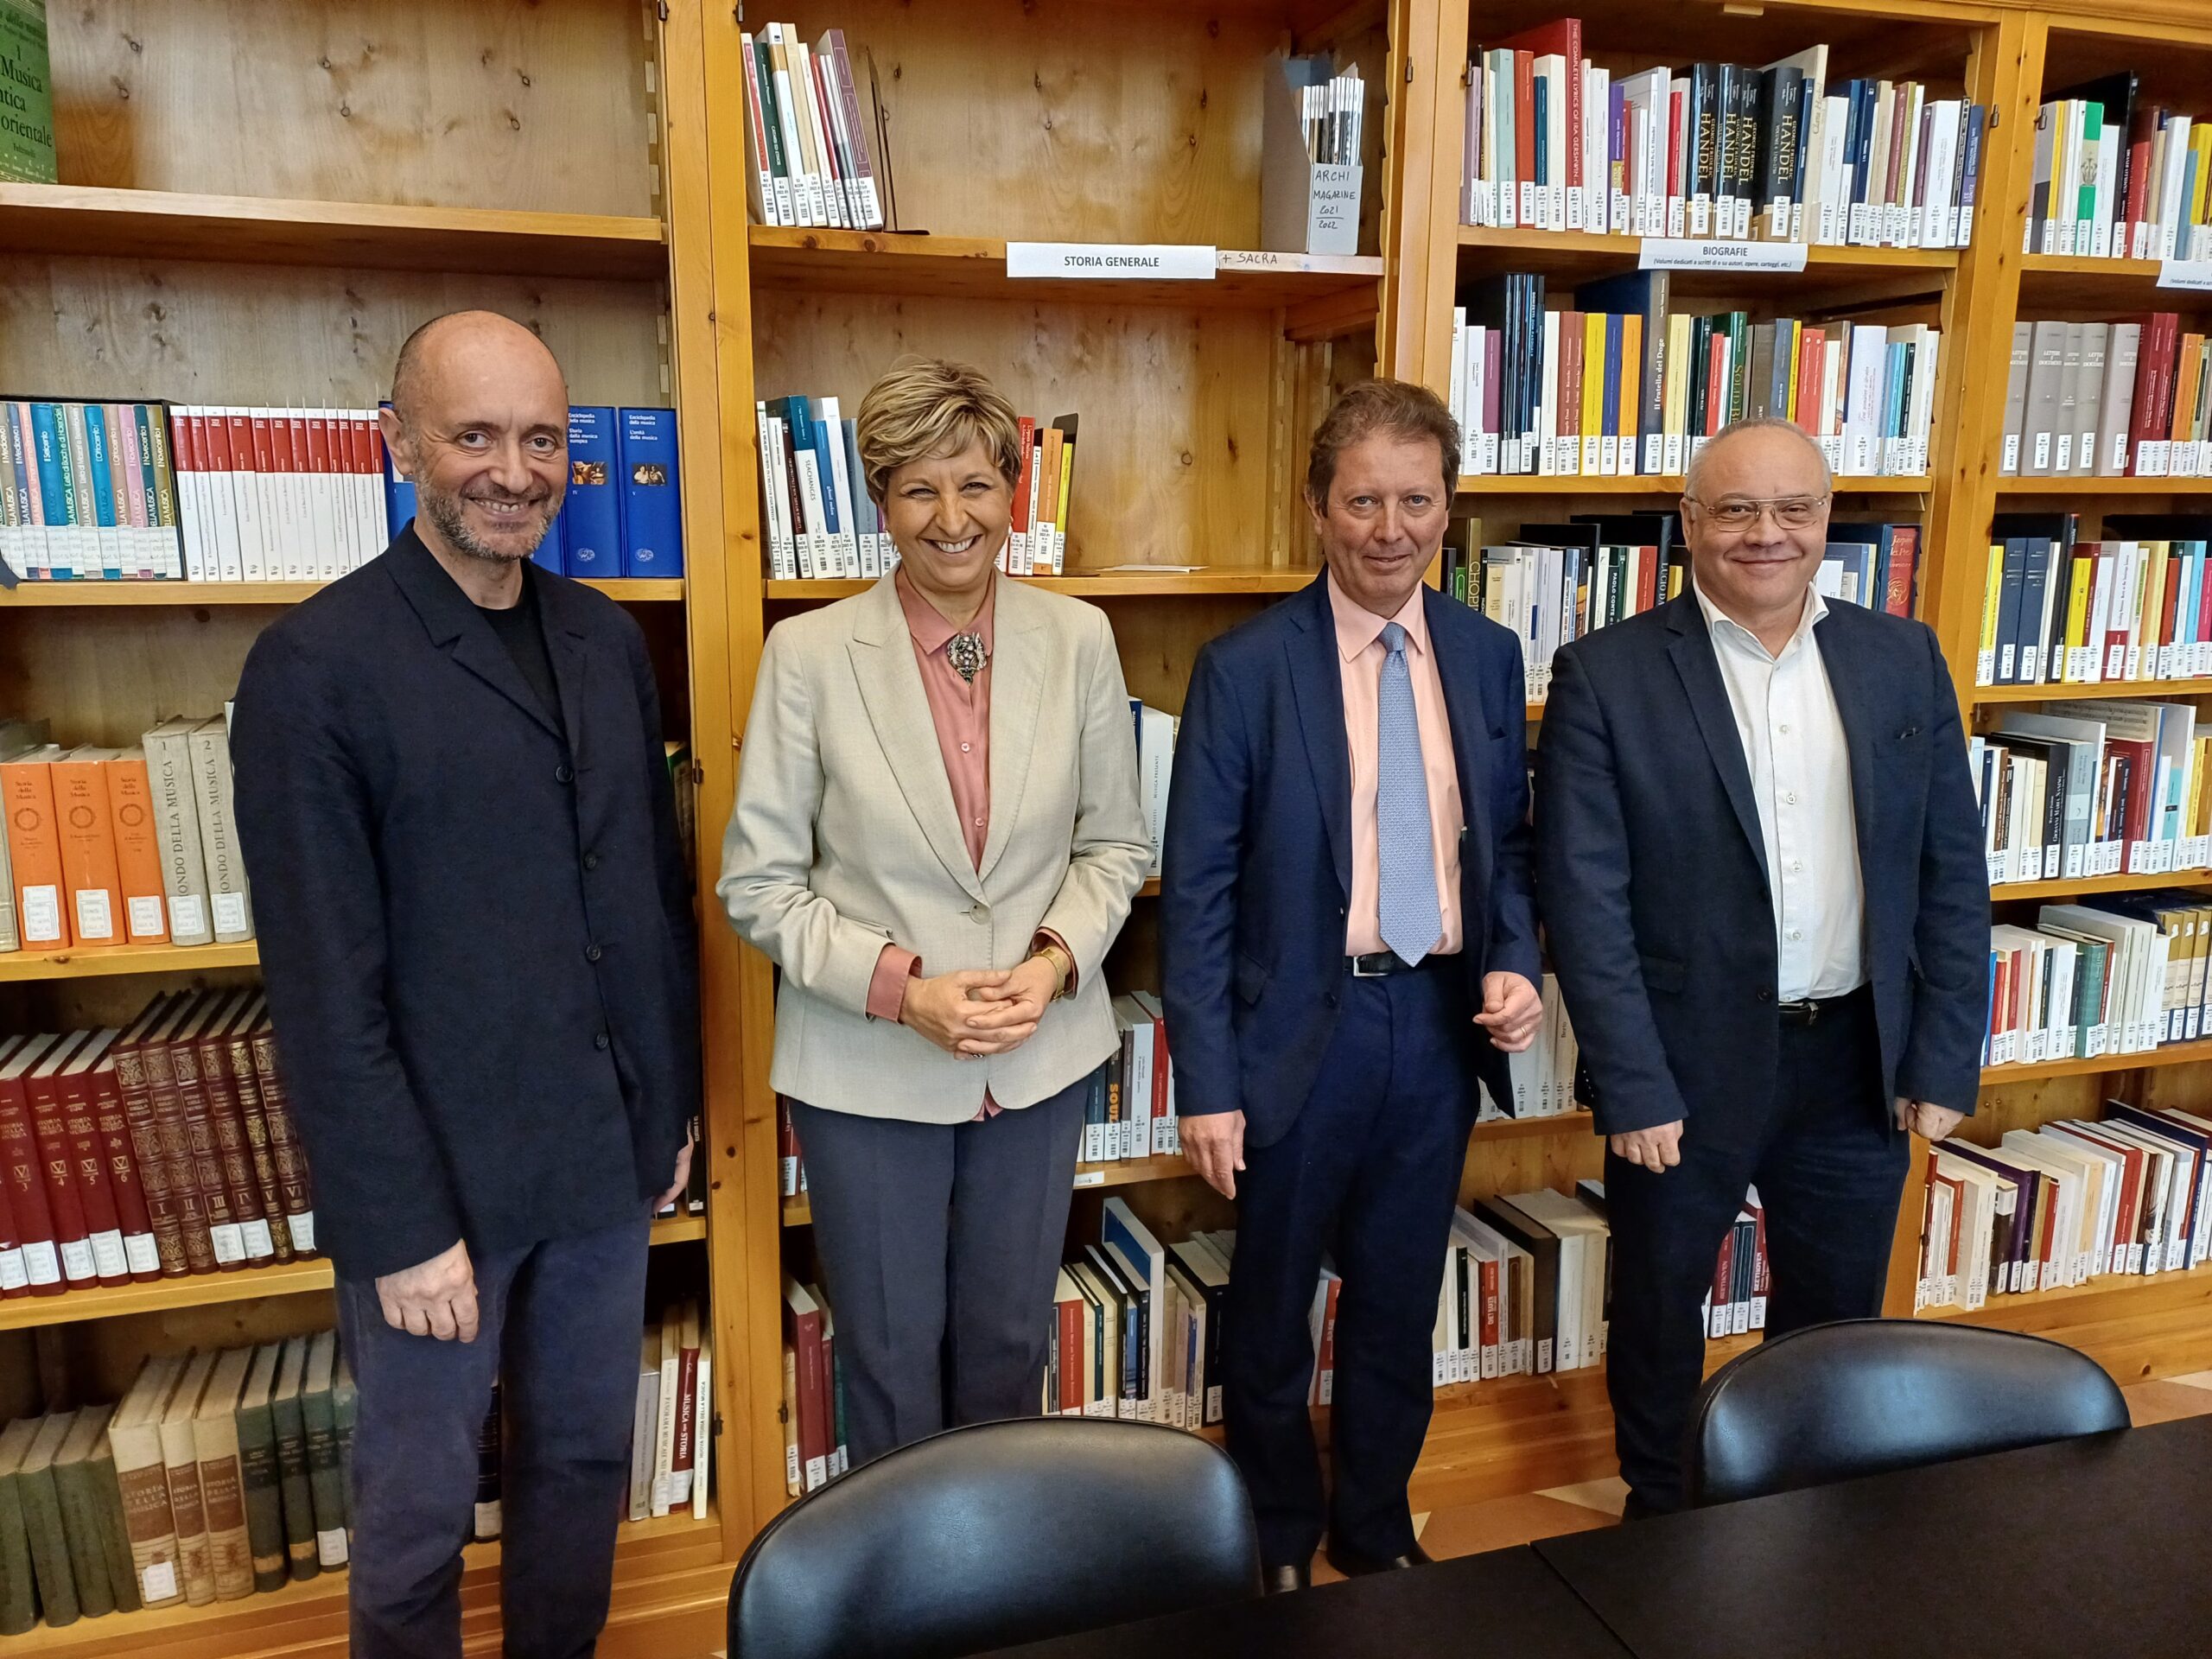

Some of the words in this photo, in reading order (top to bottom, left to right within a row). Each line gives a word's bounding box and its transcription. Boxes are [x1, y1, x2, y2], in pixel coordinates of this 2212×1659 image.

[1, 54, 42, 93] Musica
[1573, 110, 1580, 120] OF
[1, 114, 53, 148] orientale
[1698, 112, 1712, 183] HANDEL
[1722, 112, 1737, 183] HANDEL
[1738, 116, 1753, 186] HANDEL
[1777, 114, 1793, 185] HANDEL
[1315, 169, 1350, 182] ARCHI
[1313, 190, 1356, 200] MAGAZINE
[1319, 205, 1338, 214] 2021
[1319, 219, 1338, 229] 2022
[1064, 256, 1102, 267] STORIA
[1106, 257, 1160, 268] GENERALE
[1236, 252, 1278, 264] SACRA
[1702, 246, 1748, 257] BIOGRAFIE
[1654, 373, 1662, 402] fratello
[1732, 364, 1744, 404] SOLID
[0, 429, 9, 460] Medioevo
[13, 429, 22, 461] Medioevo
[42, 431, 51, 458] Seicento
[142, 430, 150, 461] Novecento
[156, 432, 164, 464] Novecento
[805, 460, 816, 501] SEACHANGES
[1469, 561, 1480, 612] CHOPI
[1660, 562, 1669, 592] LUCIO
[161, 741, 167, 751] 1
[204, 741, 212, 750] 2
[165, 759, 178, 810] MUSICA
[208, 757, 221, 807] MUSICA
[171, 812, 185, 852] DELLA
[213, 810, 226, 850] DELLA
[89, 1176, 96, 1185] 5
[120, 1173, 128, 1183] 6
[213, 1196, 226, 1208] III
[1719, 1260, 1728, 1300] BEETHOVEN
[1753, 1251, 1763, 1292] BEETHOVEN
[682, 1394, 691, 1423] MUSICA
[679, 1432, 690, 1459] STORIA
